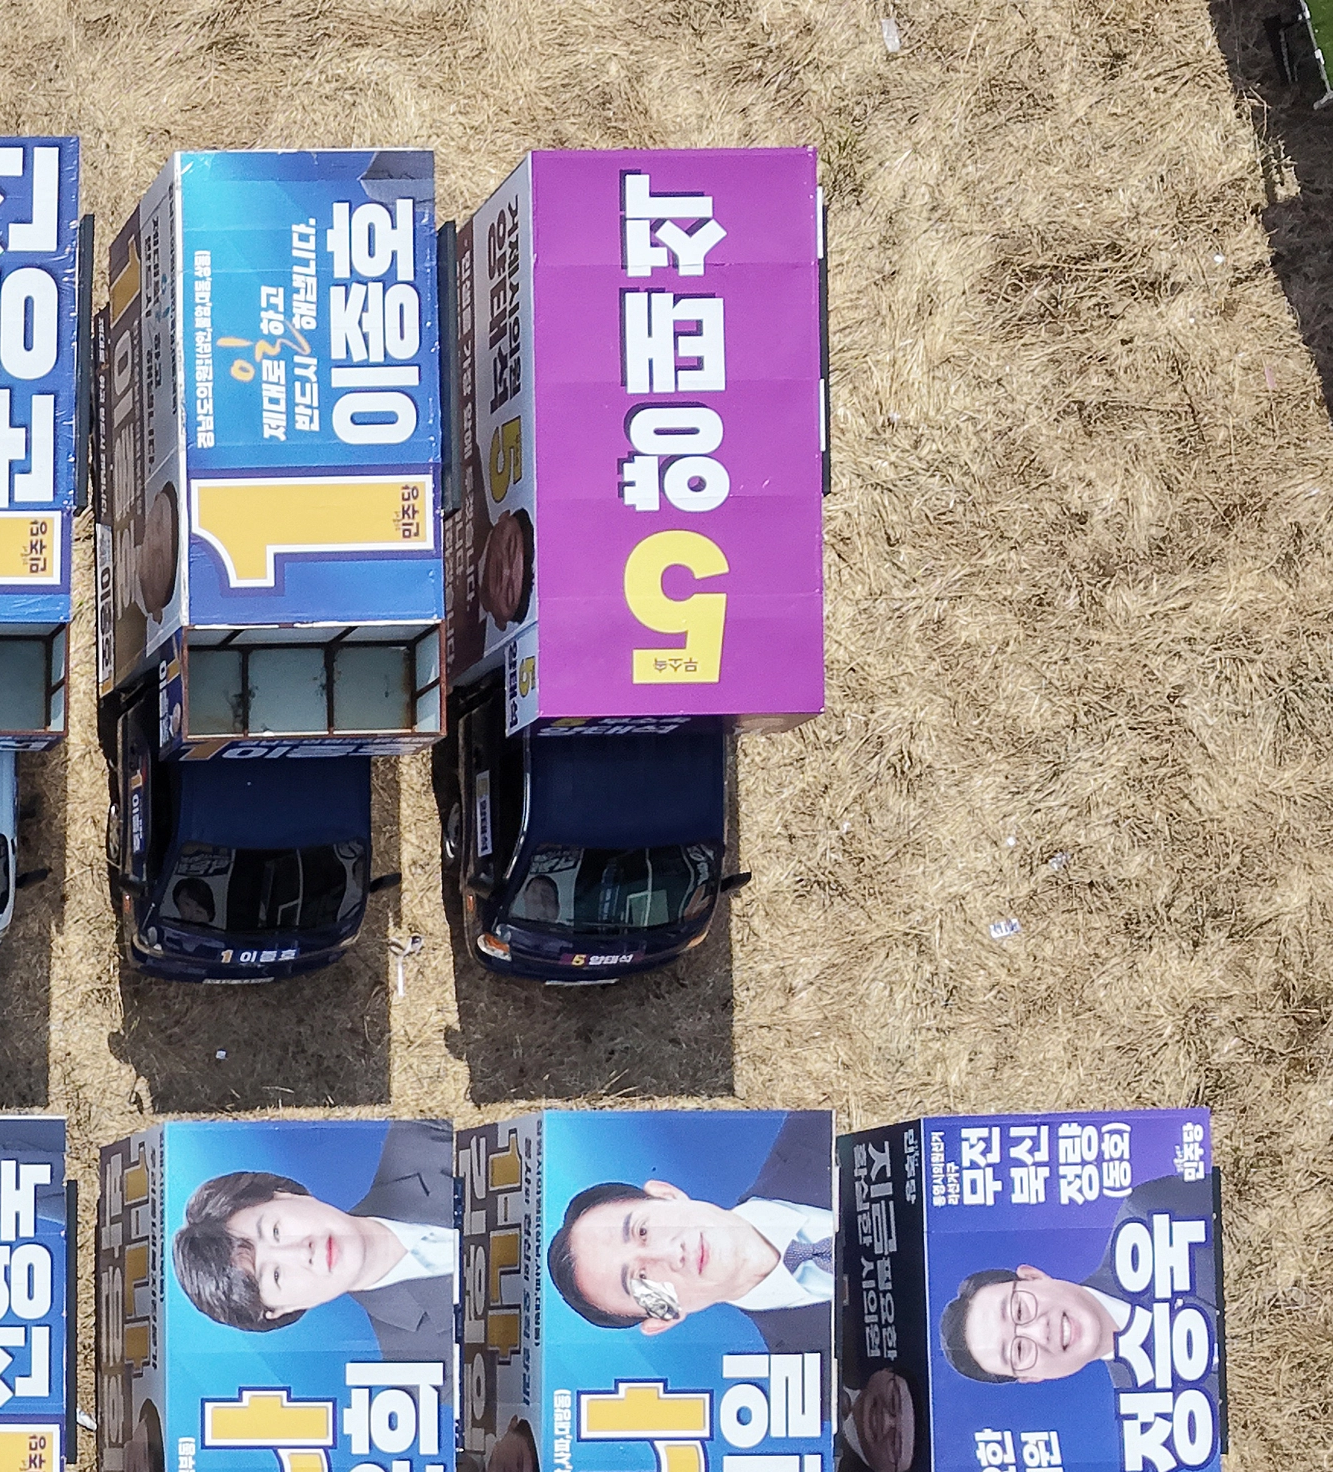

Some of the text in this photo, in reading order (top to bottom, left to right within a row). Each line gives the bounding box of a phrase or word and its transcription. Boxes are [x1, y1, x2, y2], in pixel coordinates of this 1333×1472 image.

[261, 287, 285, 336] 하고
[292, 217, 320, 431] 반드시 해냅니다.
[622, 172, 728, 513] 양태석
[191, 198, 433, 588] 1 이종호
[488, 210, 521, 503] 양태석 5
[262, 360, 287, 441] 제대로
[28, 519, 47, 574] 민주당
[402, 484, 420, 539] 민주당
[623, 529, 729, 684] 5
[519, 656, 536, 698] 5
[652, 657, 698, 674] 무소속
[961, 1127, 1002, 1206] 무전
[1008, 1126, 1050, 1203] 북신
[1058, 1123, 1101, 1203] 정량
[1183, 1122, 1204, 1180] 민주당
[124, 1143, 150, 1377] 1-나
[1113, 1214, 1215, 1472] 정승욱
